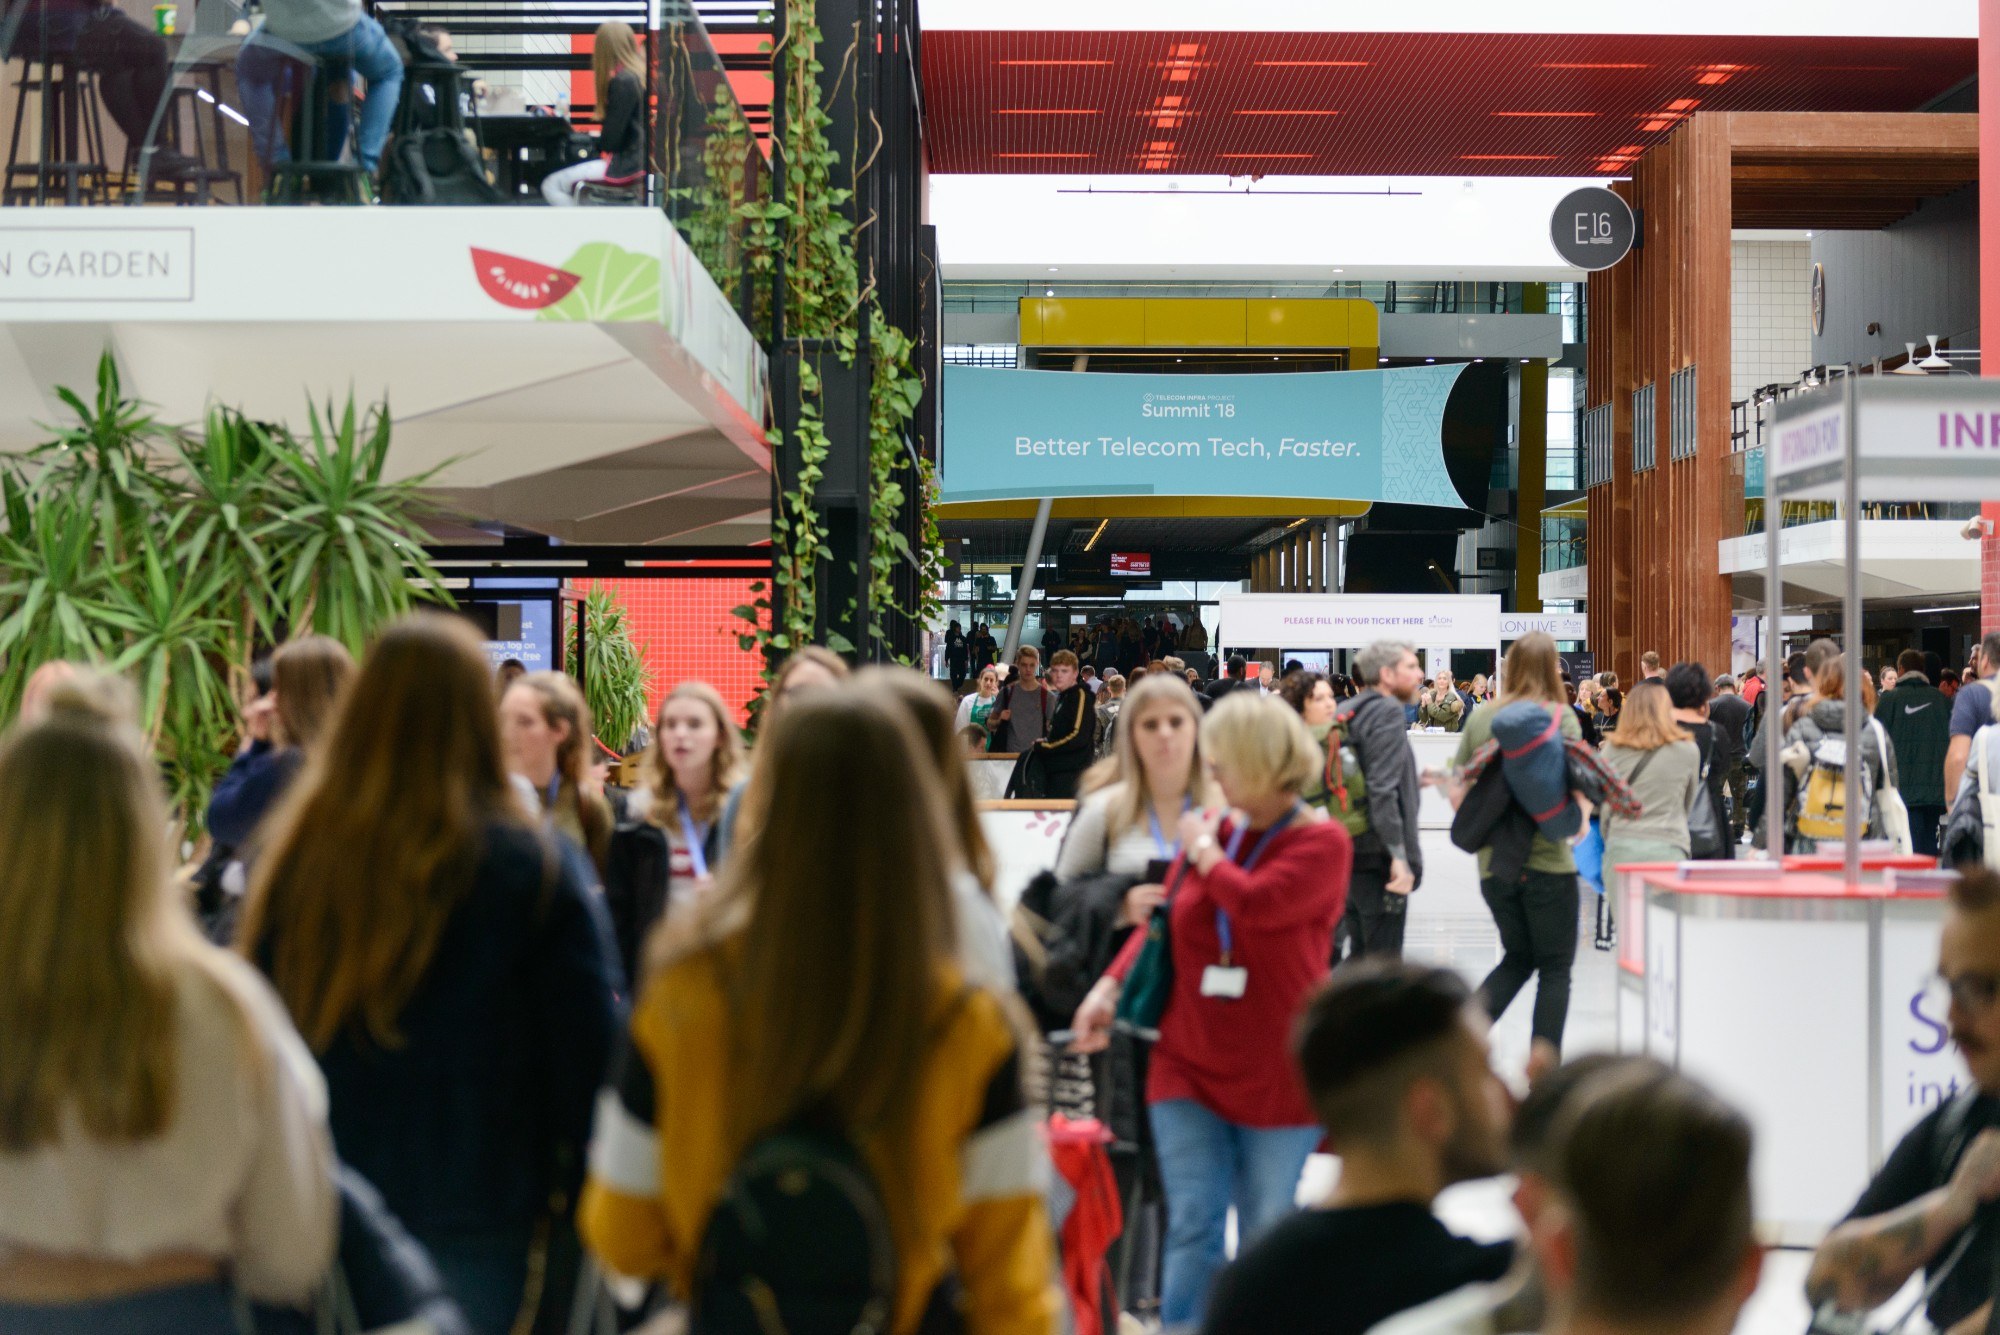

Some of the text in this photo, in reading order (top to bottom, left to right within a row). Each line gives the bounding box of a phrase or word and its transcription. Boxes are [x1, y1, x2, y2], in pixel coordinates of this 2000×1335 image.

[1575, 212, 1612, 245] E16
[28, 251, 169, 278] GARDEN
[1142, 403, 1211, 418] Summit
[1015, 436, 1361, 460] Better Telecom Tech, Faster.
[1284, 617, 1424, 625] PLEASE FILL IN YOUR TICKET HERE
[508, 641, 522, 651] log
[523, 651, 541, 661] free
